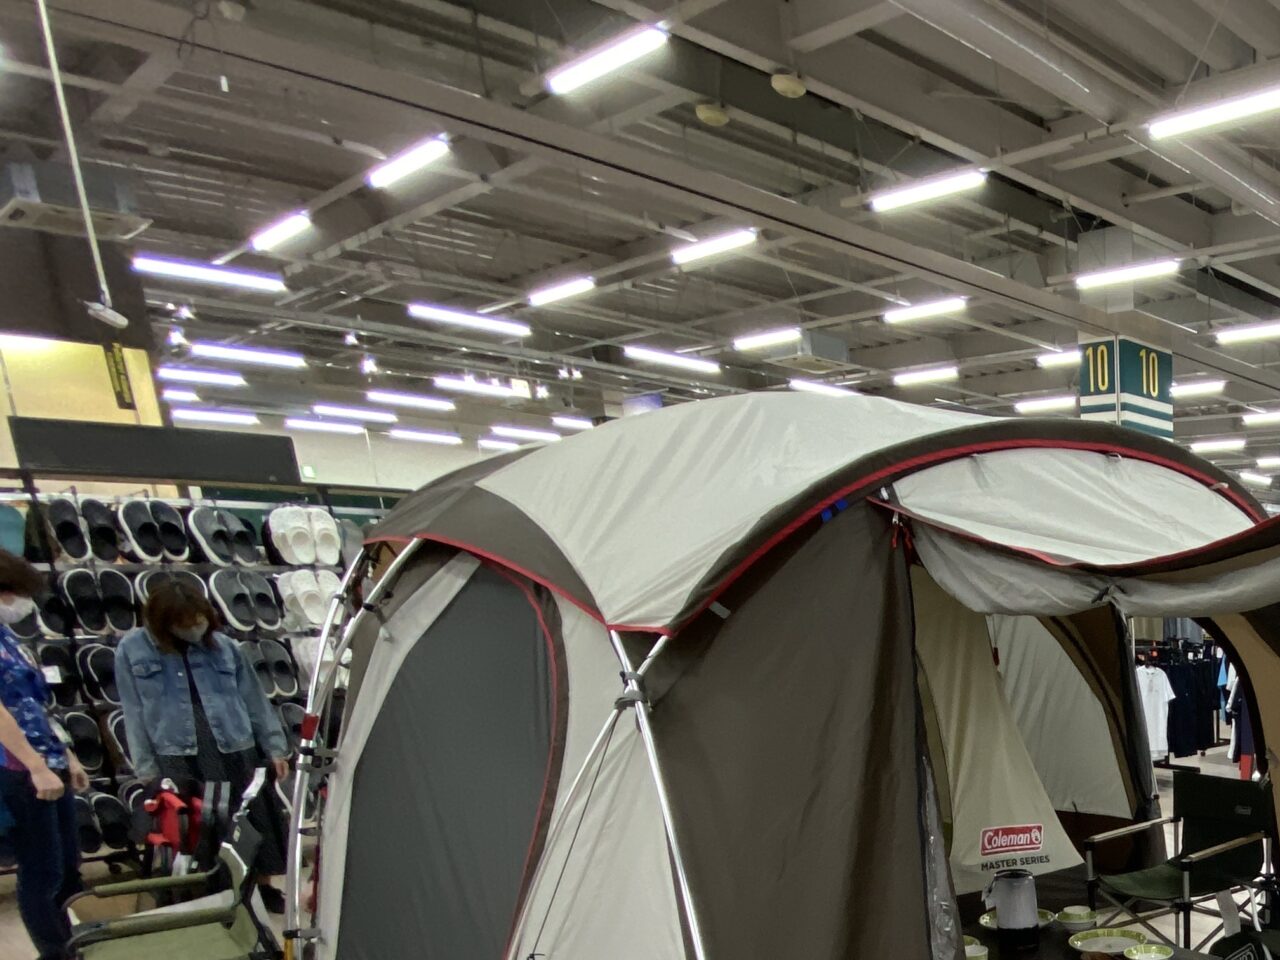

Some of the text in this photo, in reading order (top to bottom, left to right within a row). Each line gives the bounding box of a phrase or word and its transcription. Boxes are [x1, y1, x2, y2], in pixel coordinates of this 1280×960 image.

[1086, 345, 1109, 392] 10
[1139, 349, 1159, 397] 10
[984, 829, 1030, 850] Coleman
[981, 855, 1050, 871] MASTER SERIES
